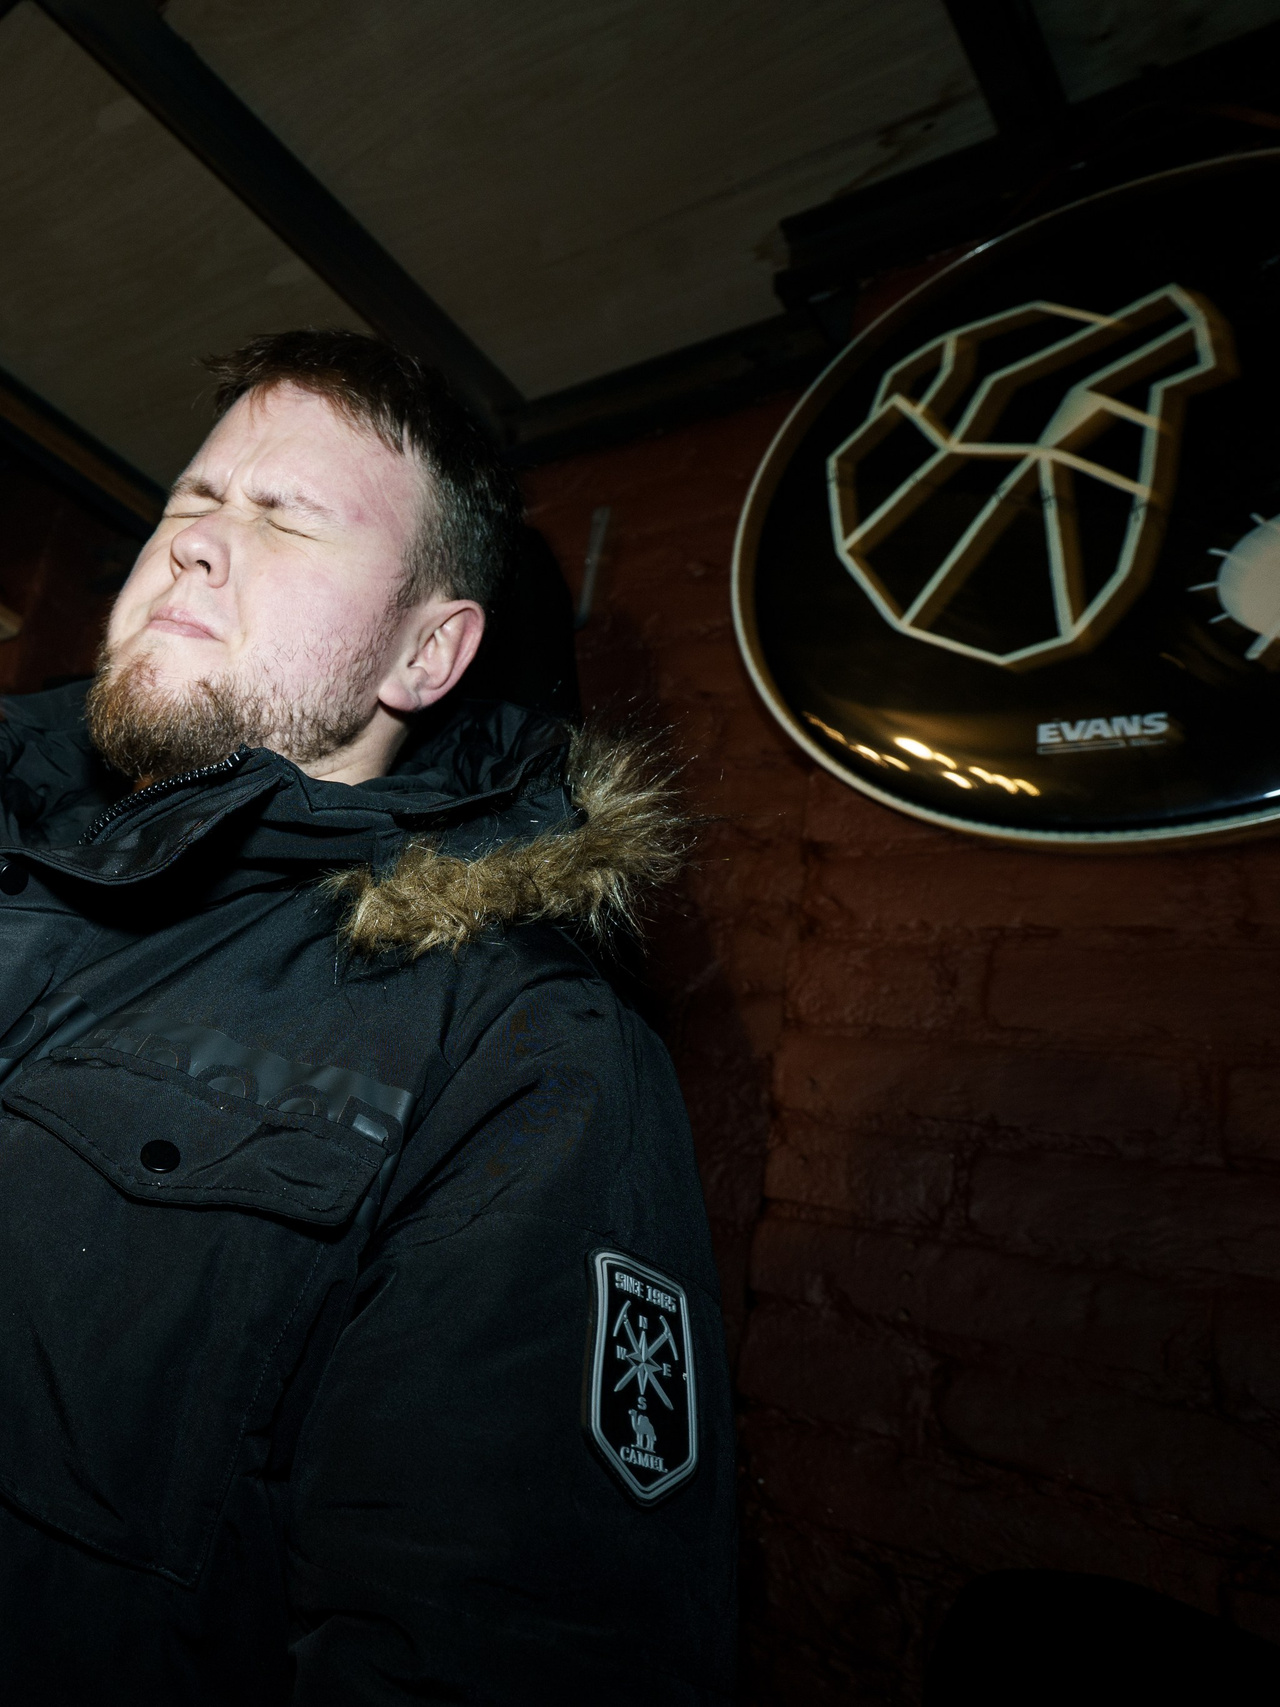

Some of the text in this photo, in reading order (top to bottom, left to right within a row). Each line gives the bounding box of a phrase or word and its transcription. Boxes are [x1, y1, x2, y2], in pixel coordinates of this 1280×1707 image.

[1037, 711, 1169, 745] EVANS
[614, 1271, 677, 1313] SINCE 1965
[638, 1315, 649, 1330] N
[616, 1346, 628, 1360] W
[662, 1363, 673, 1378] E
[637, 1396, 648, 1411] S
[620, 1446, 669, 1474] CAMEL
